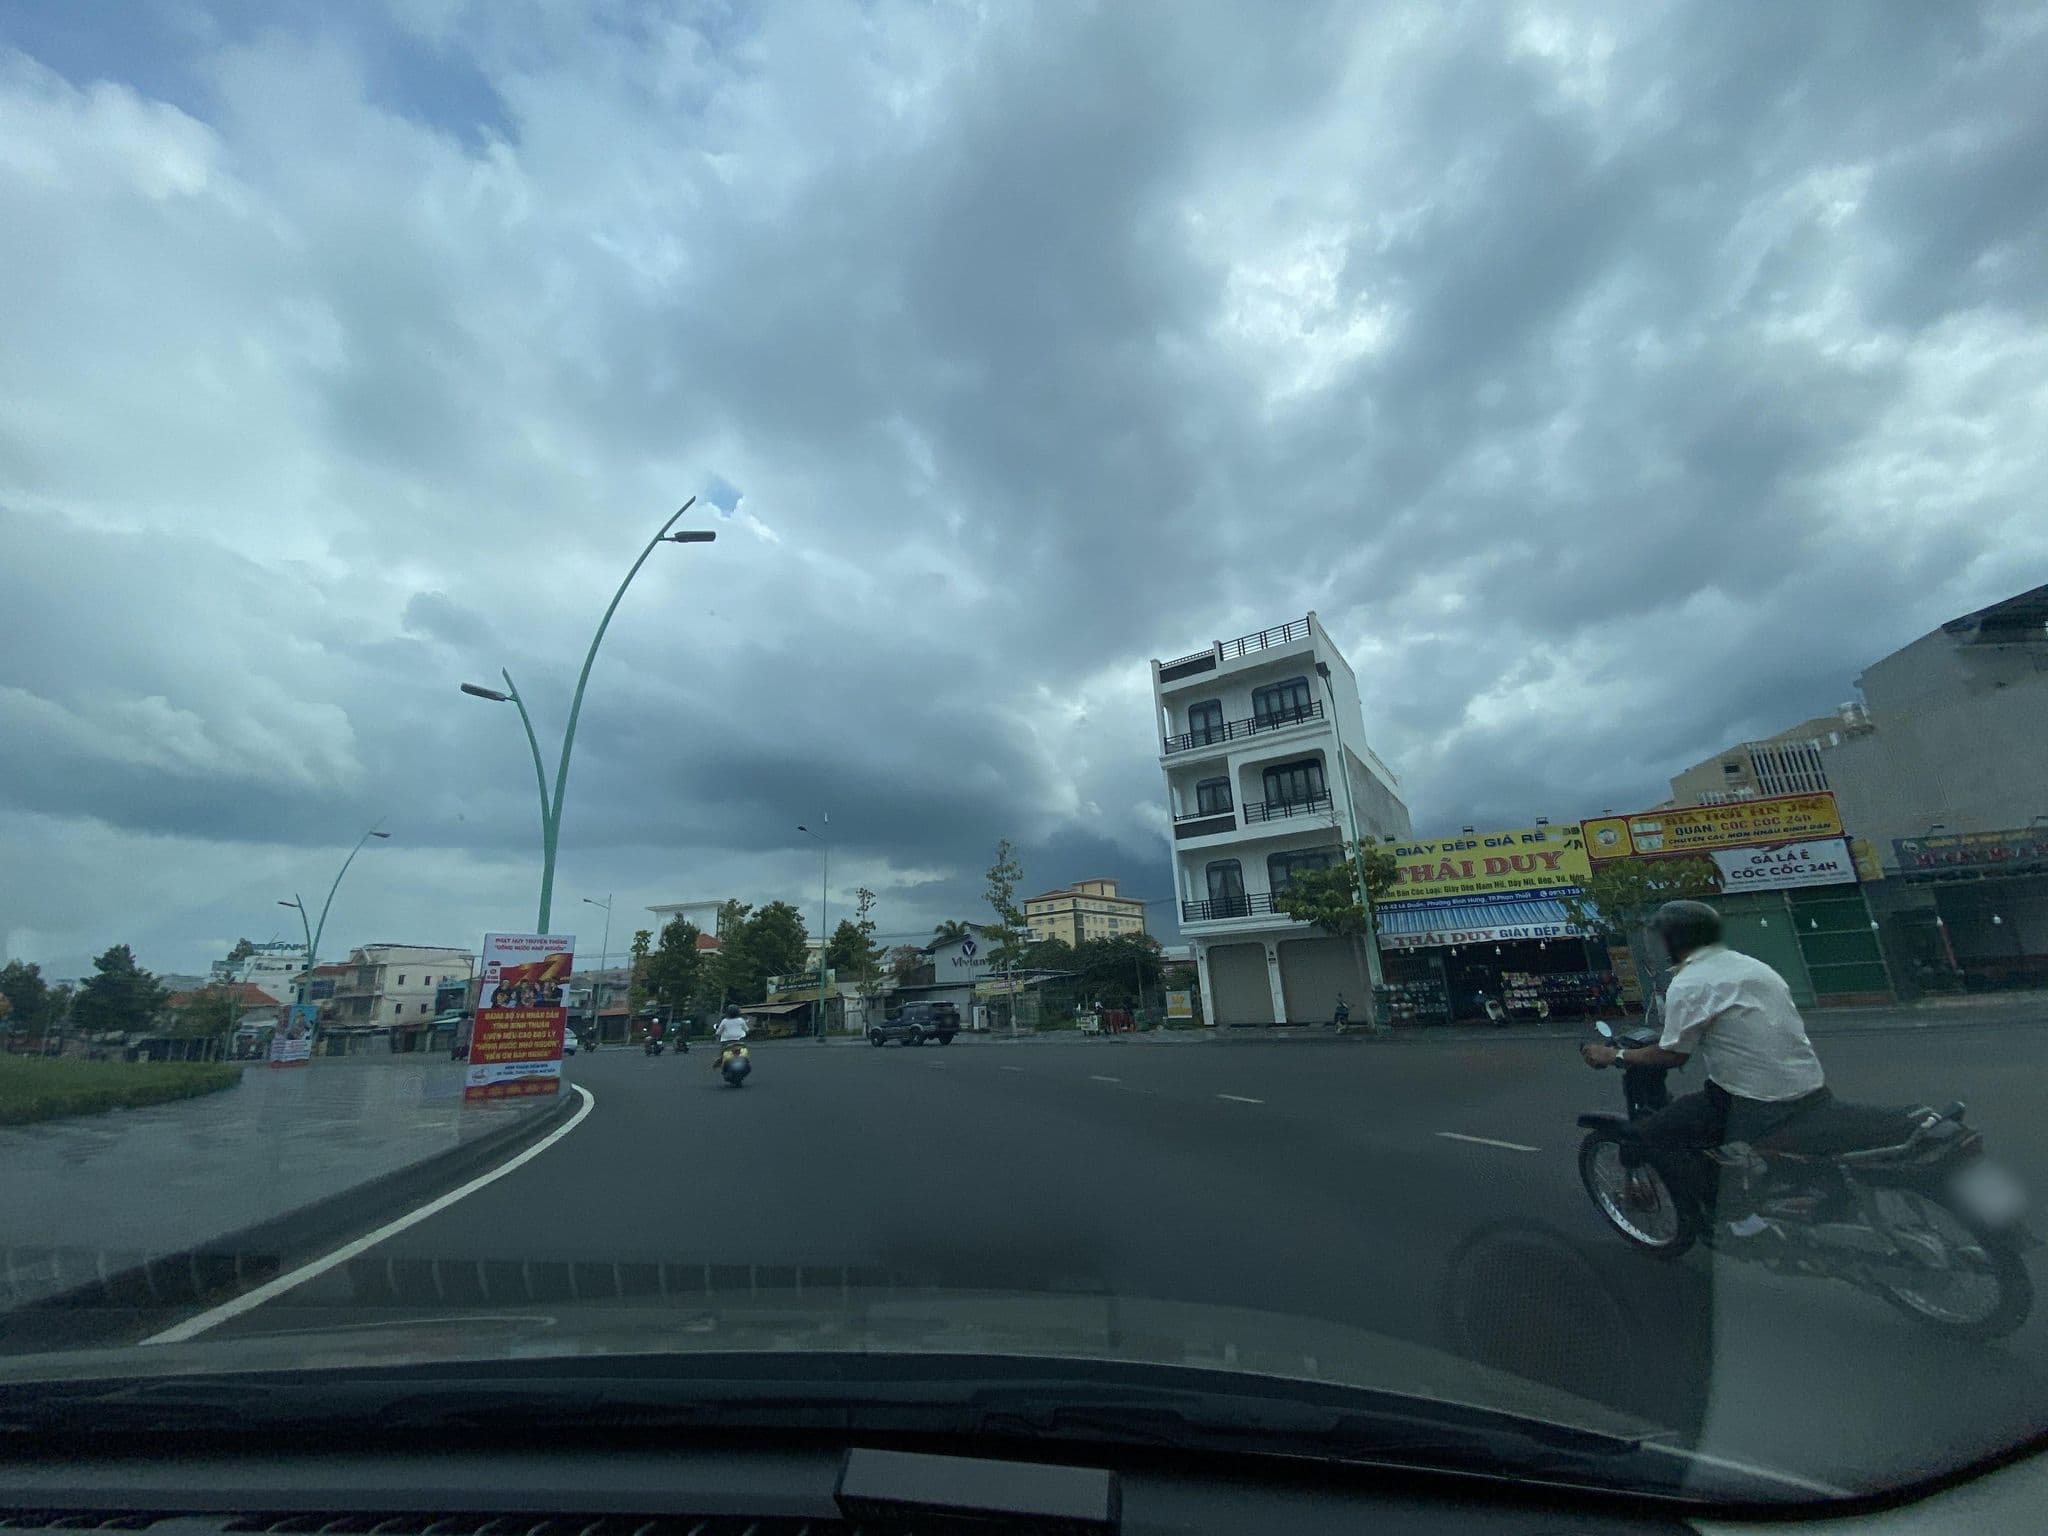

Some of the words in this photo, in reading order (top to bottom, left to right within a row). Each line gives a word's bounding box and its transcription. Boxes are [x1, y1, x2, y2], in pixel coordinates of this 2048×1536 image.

[1483, 850, 1565, 877] DUY
[1808, 861, 1838, 872] 24H
[1534, 924, 1560, 936] DÉP
